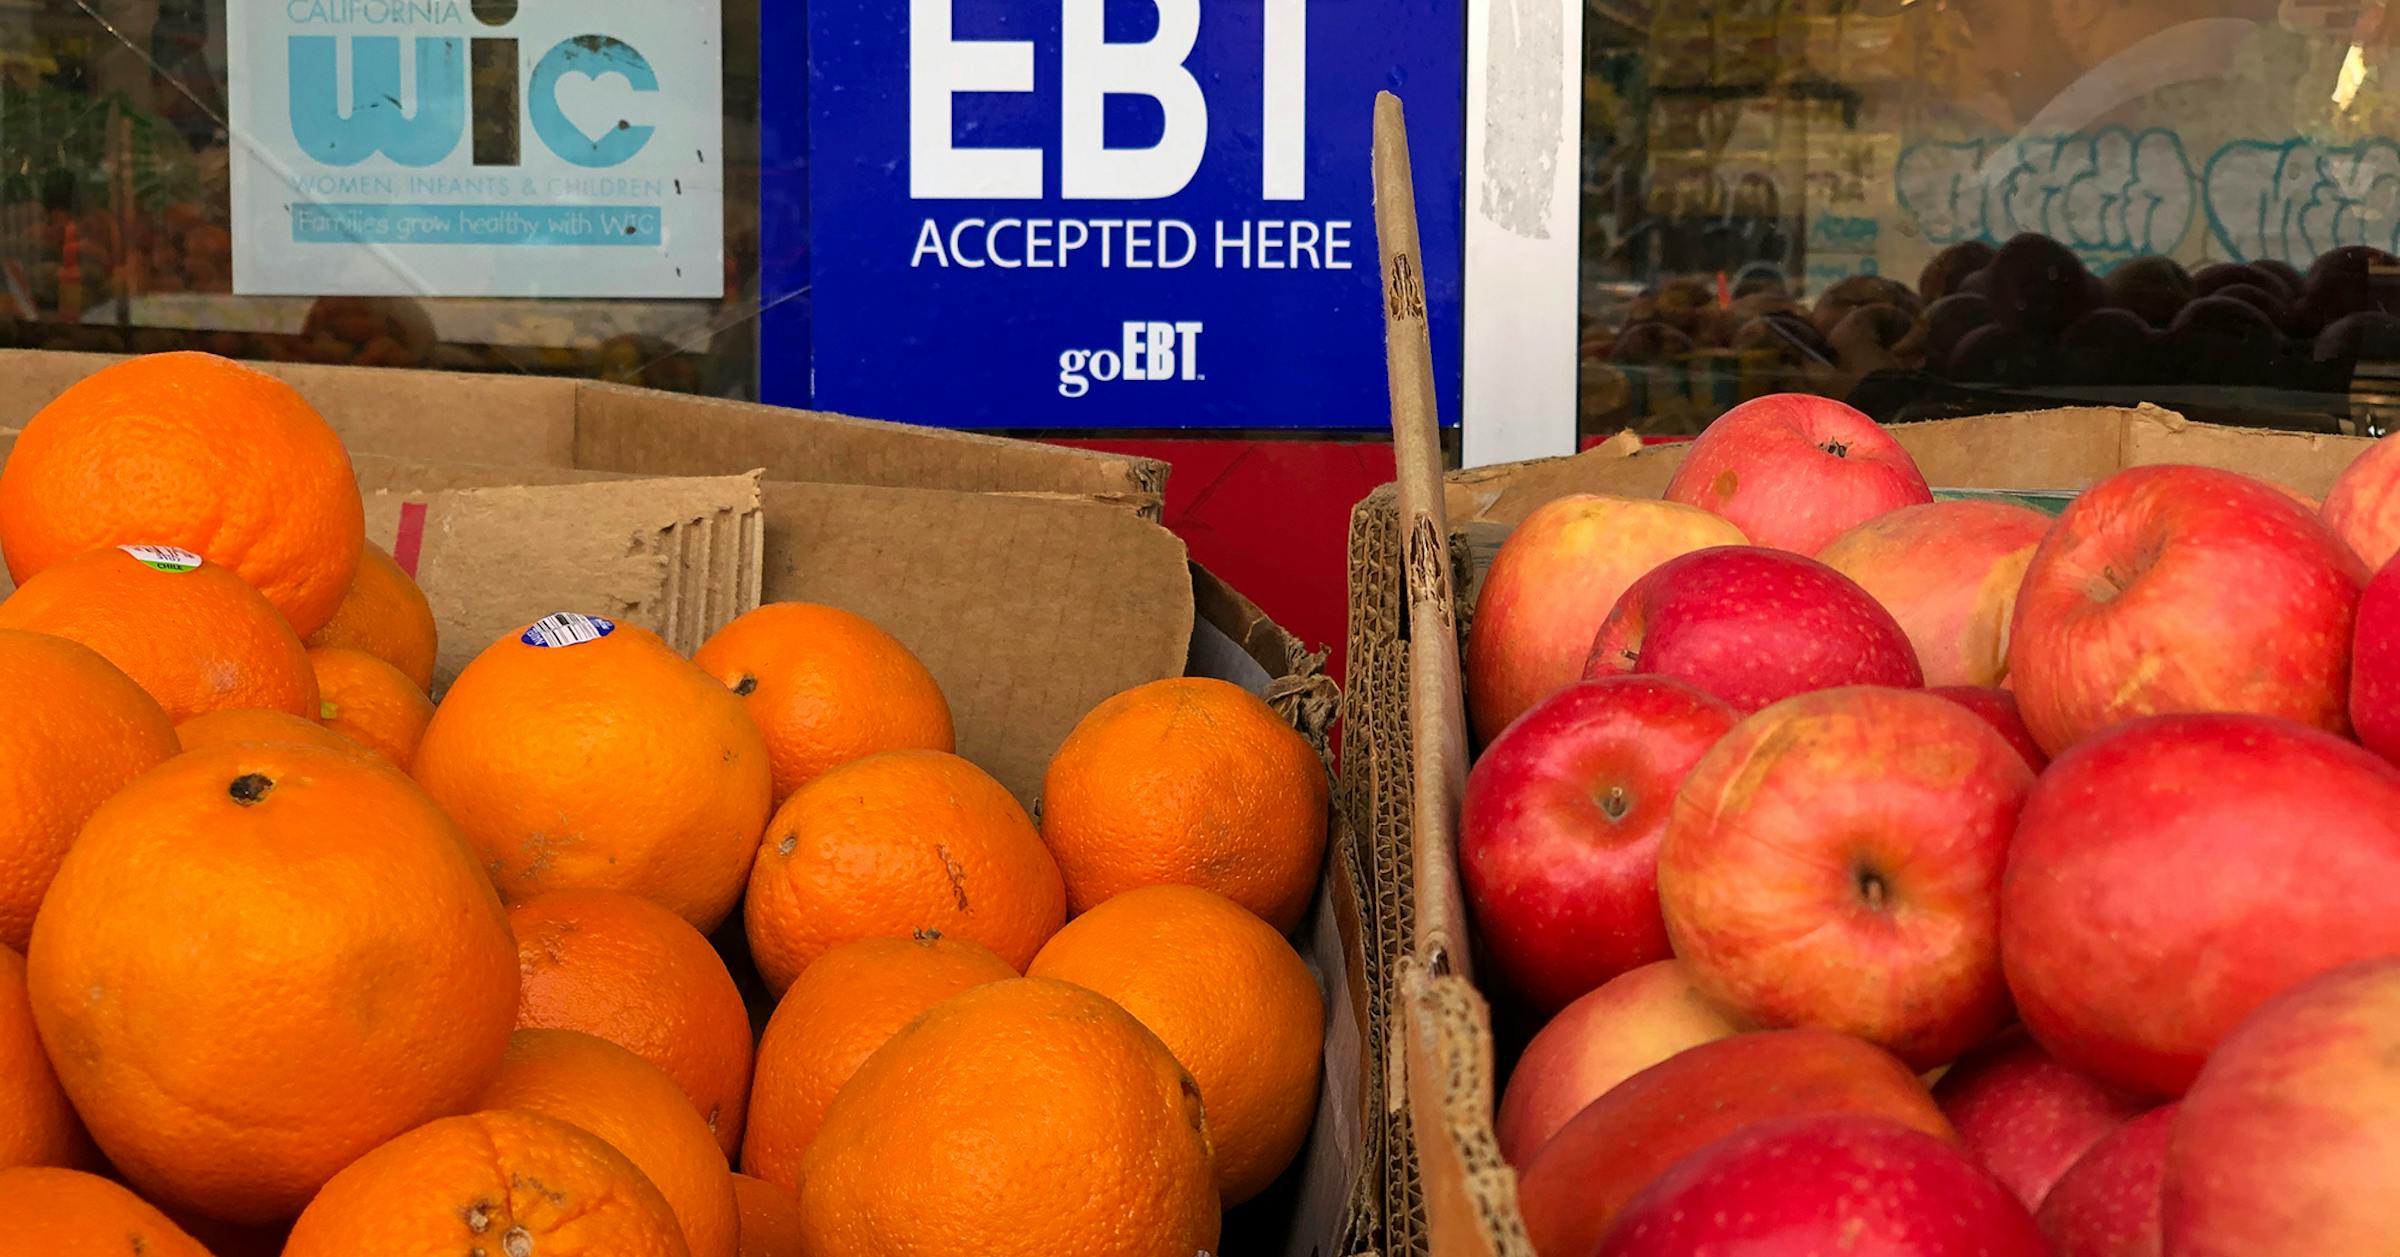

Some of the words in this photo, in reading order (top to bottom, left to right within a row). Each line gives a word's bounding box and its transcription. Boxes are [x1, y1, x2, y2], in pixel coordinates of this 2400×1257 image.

[287, 0, 463, 24] CALIFORNIA
[409, 176, 510, 197] INFANTS
[521, 177, 537, 196] &
[547, 176, 662, 197] CHILDREN
[299, 209, 389, 234] Families
[396, 215, 451, 239] grow
[459, 208, 539, 240] healthy
[547, 211, 592, 236] with
[600, 211, 655, 236] WIC
[911, 218, 1197, 268] ACCEPTED
[1214, 219, 1352, 268] HERE
[157, 562, 183, 571] CHILE
